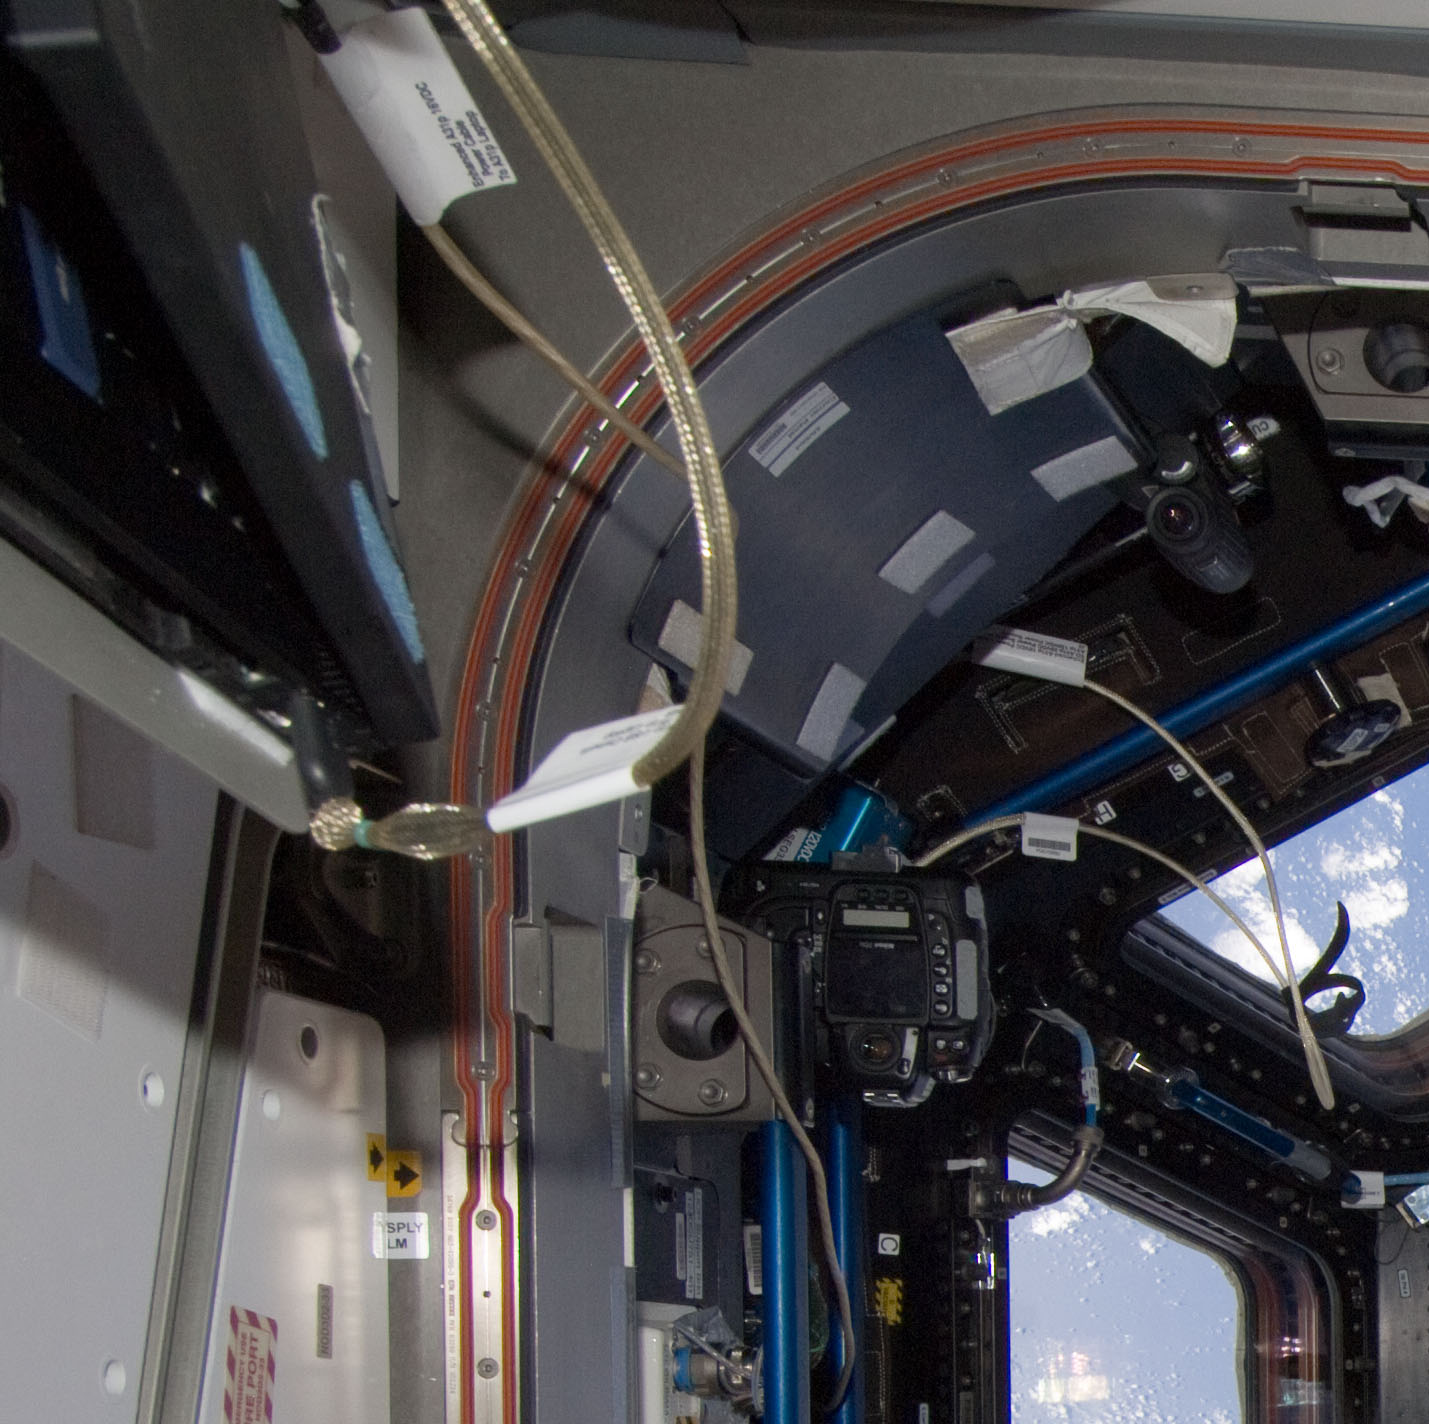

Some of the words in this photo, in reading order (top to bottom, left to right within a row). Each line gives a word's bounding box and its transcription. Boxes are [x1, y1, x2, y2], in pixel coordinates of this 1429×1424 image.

[437, 115, 457, 140] A31p
[455, 119, 476, 147] Cable
[465, 110, 490, 144] Laptop
[449, 141, 485, 188] Enhanced
[471, 148, 494, 176] Power
[880, 1237, 898, 1251] C
[240, 1332, 248, 1356] USE
[246, 1332, 259, 1389] PORT
